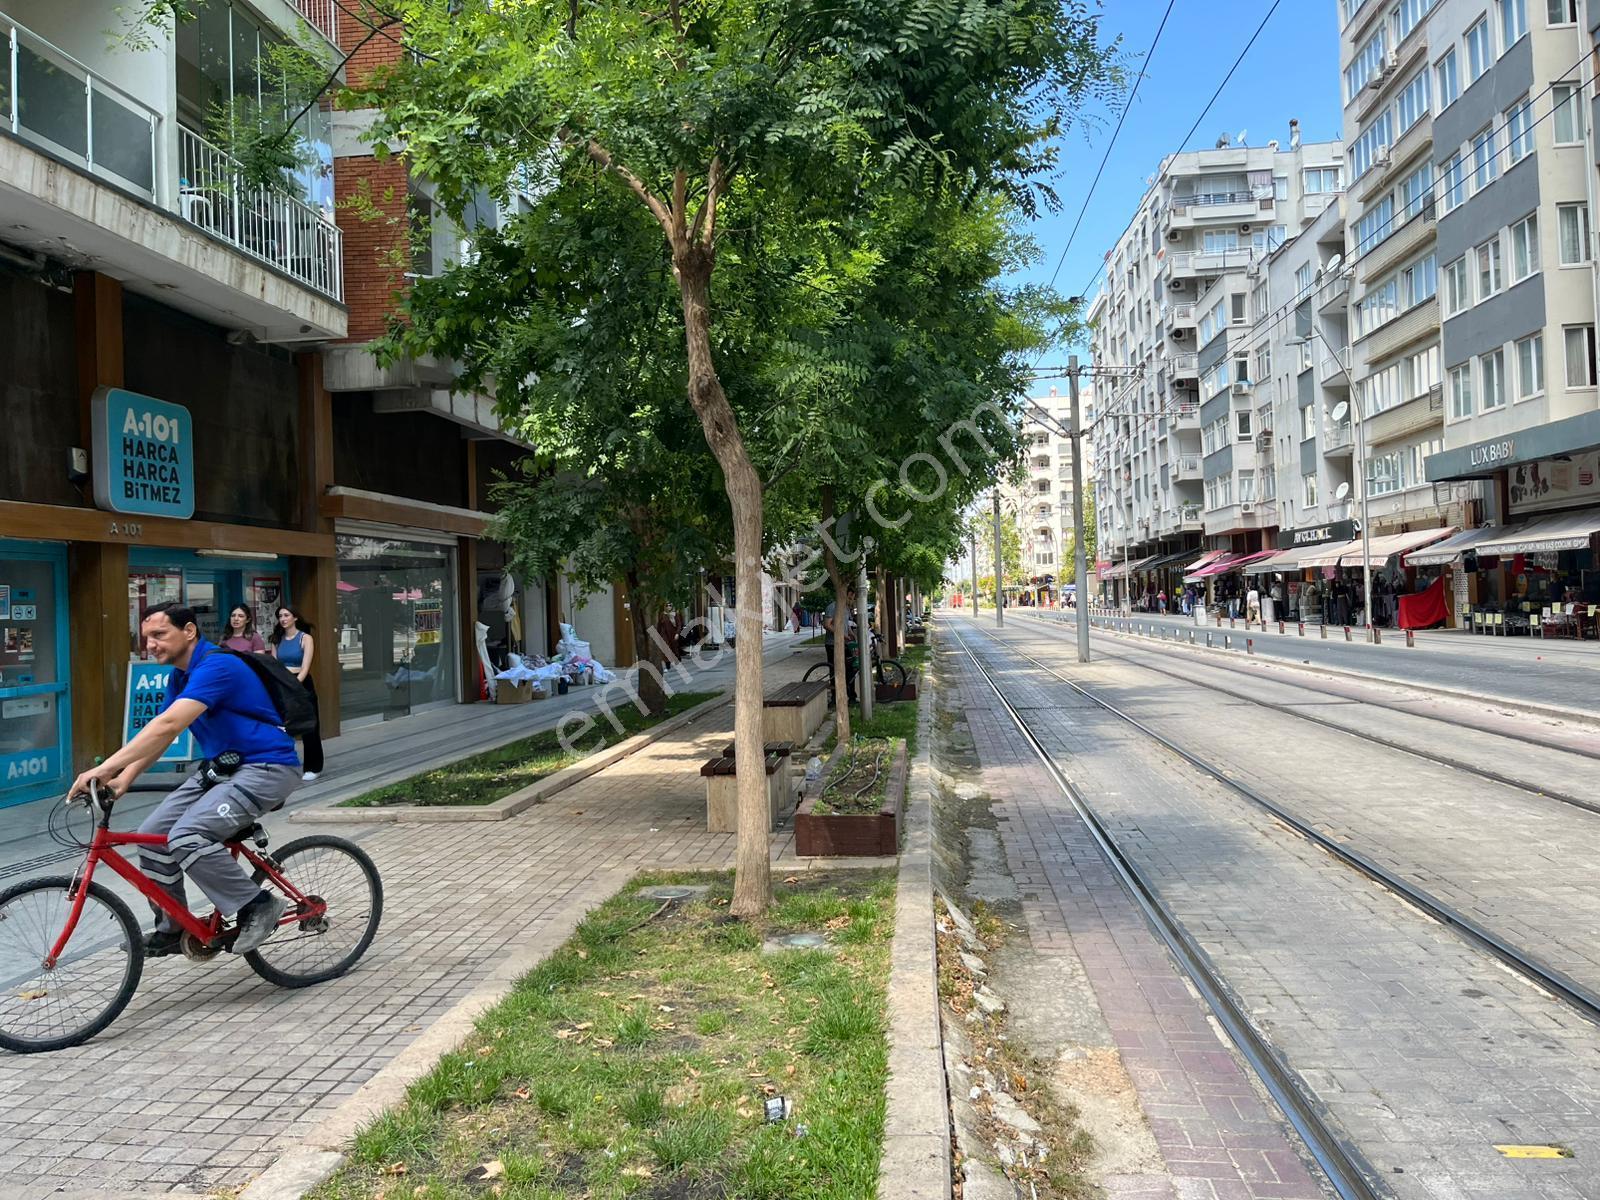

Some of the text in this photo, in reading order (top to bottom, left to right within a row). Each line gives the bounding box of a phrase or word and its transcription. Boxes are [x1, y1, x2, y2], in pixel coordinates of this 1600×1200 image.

[123, 437, 179, 464] HARCA
[1489, 440, 1515, 461] BABY
[123, 459, 180, 484] HARCA
[110, 522, 143, 536] A 101
[135, 692, 165, 703] HAR
